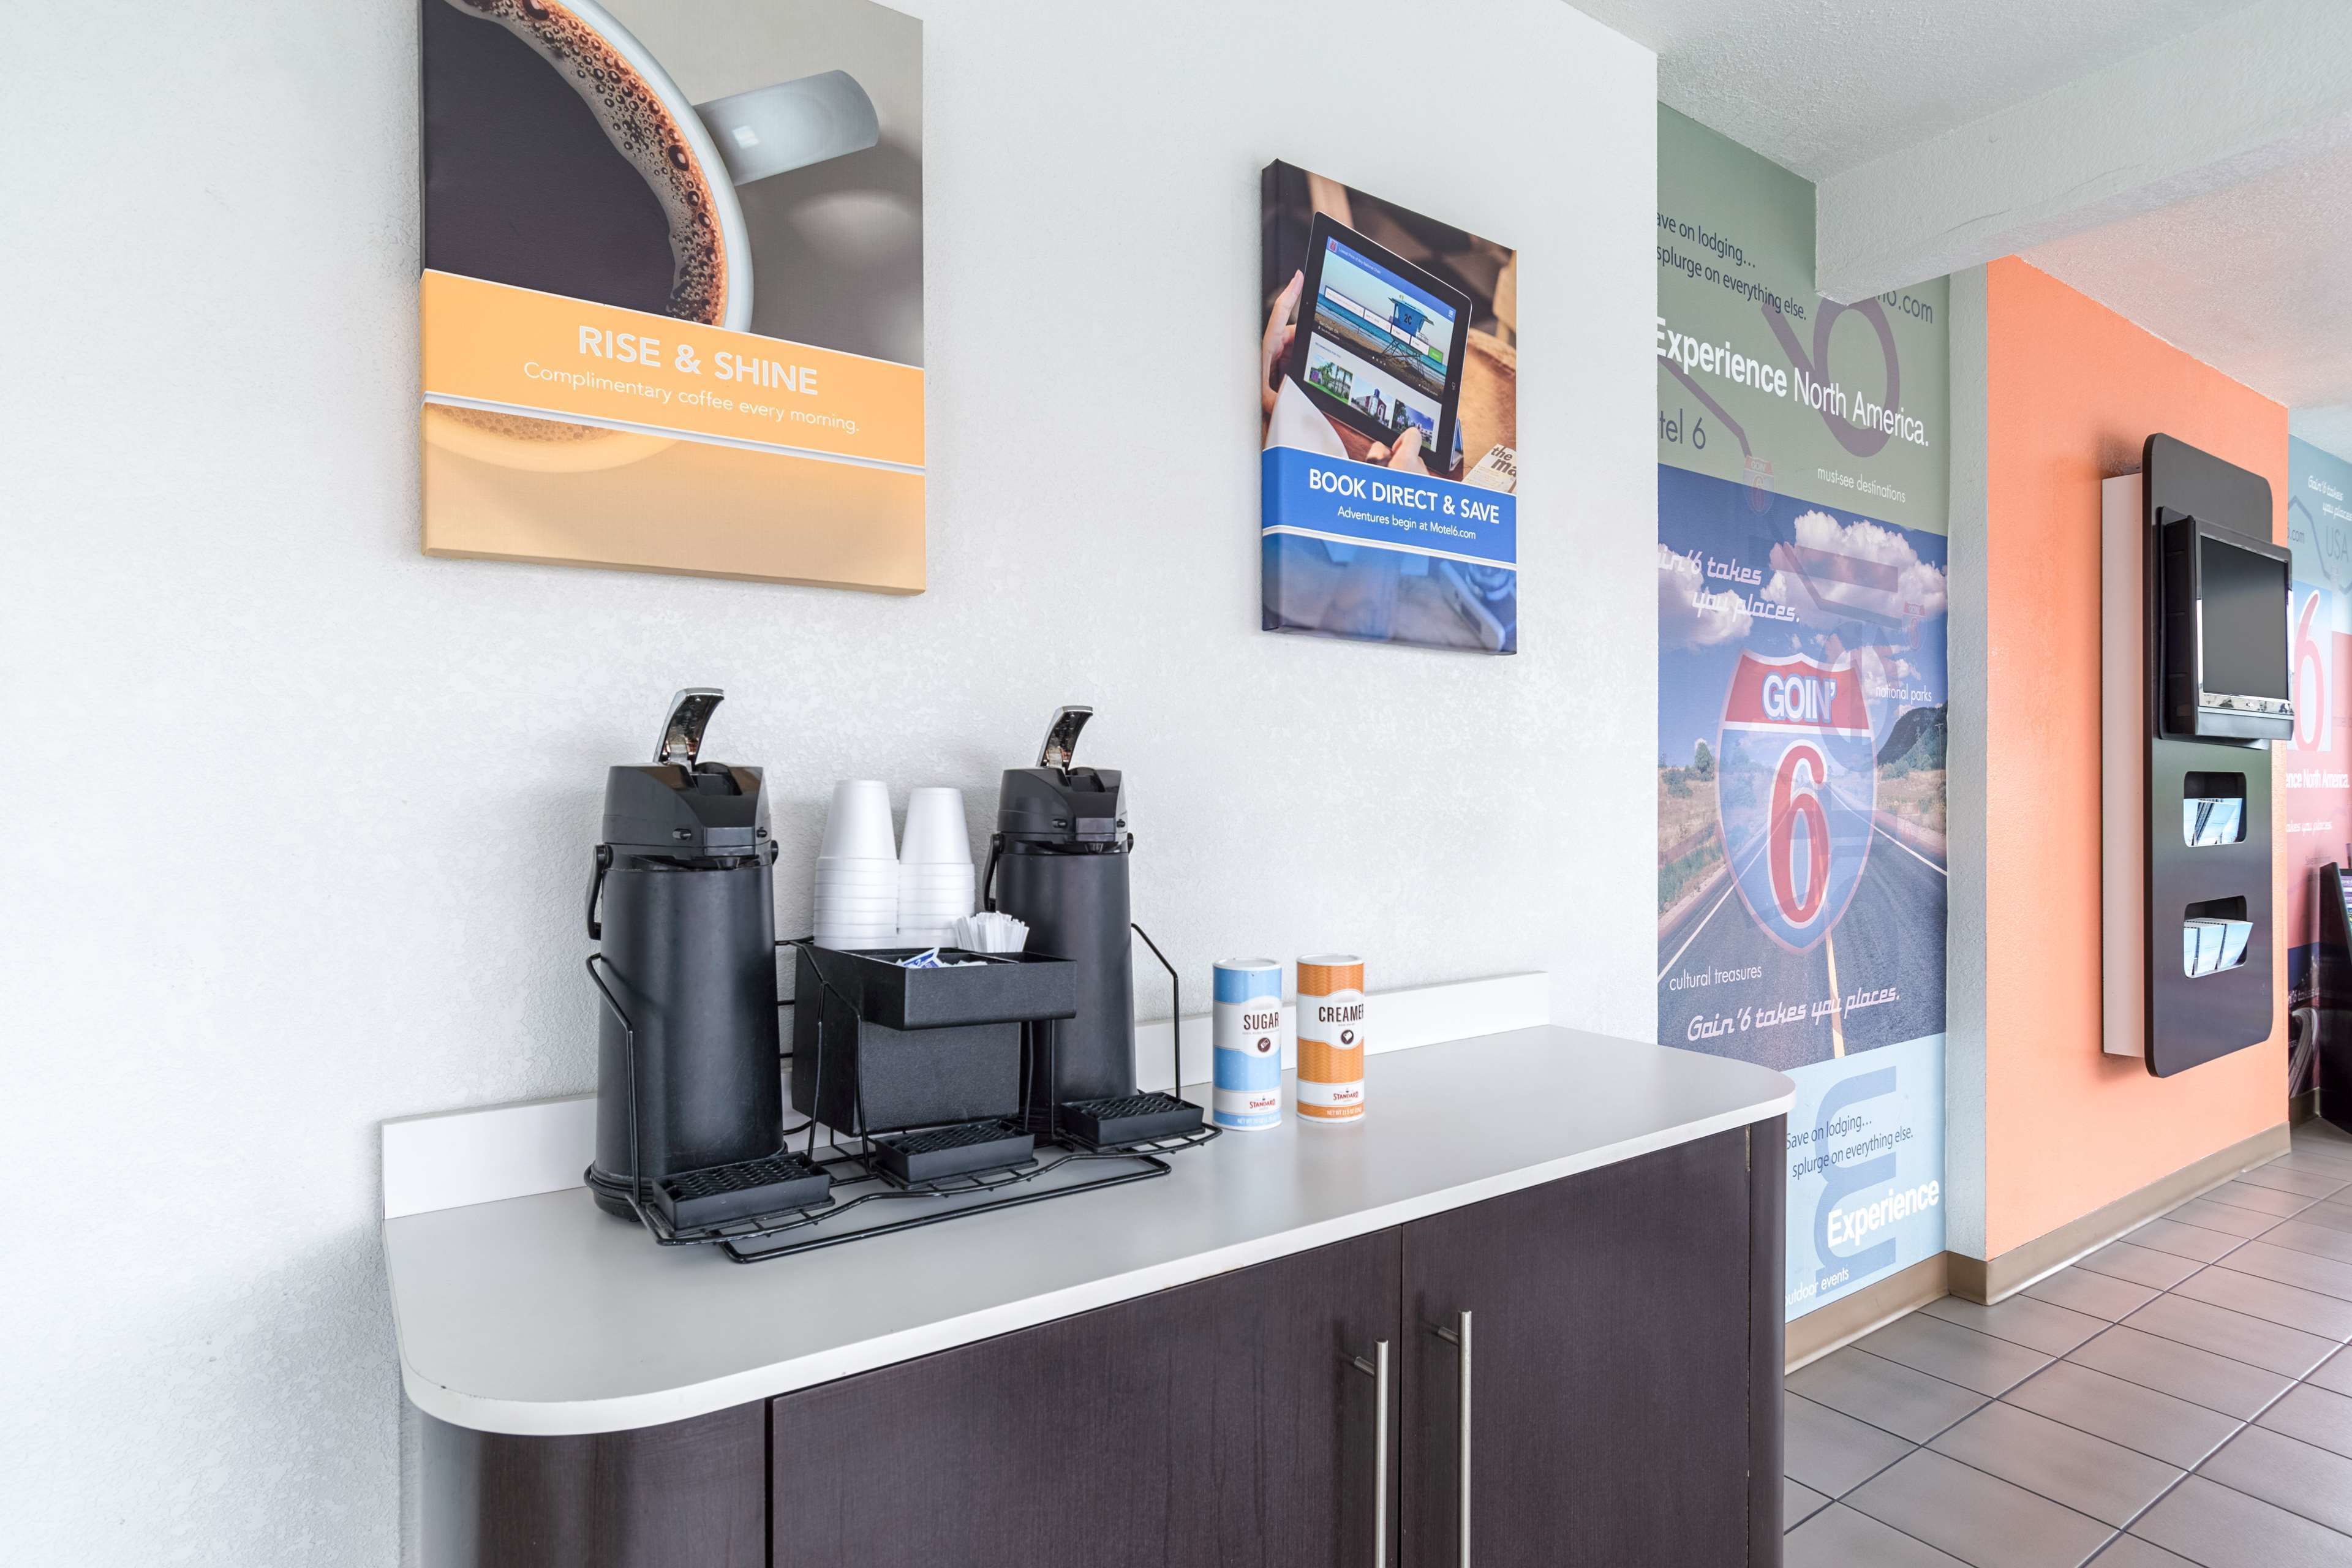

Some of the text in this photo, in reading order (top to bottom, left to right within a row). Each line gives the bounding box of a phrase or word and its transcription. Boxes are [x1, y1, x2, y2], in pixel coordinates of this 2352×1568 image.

[1679, 224, 1695, 241] on
[1698, 225, 1755, 268] lodging...
[1657, 246, 1807, 321] splurge on everything else.
[579, 325, 819, 396] RISE & SHINE
[524, 361, 859, 435] Complimentary coffee every morning.
[1657, 316, 1929, 447] Experience North America.
[1660, 408, 1706, 450] tel 6
[1491, 447, 1513, 461] the
[1310, 468, 1499, 524] BOOK DIRECT & SAVE
[1817, 467, 1905, 503] must-see destinations
[1338, 505, 1476, 540] Adventures begin at Motel6.com
[2288, 527, 2305, 544] .com
[2326, 526, 2348, 562] USA
[1707, 557, 1762, 586] takes
[1692, 592, 1800, 623] you places.
[1762, 672, 1838, 723] GOIN'
[1875, 684, 1932, 705] national parks
[1767, 739, 1833, 929] 6
[1669, 964, 1762, 991] cultural treasures
[1243, 1012, 1279, 1030] SUGAR
[1755, 1001, 1806, 1027] takes
[1811, 998, 1841, 1025] you
[1844, 986, 1900, 1019] places.
[1787, 1115, 1872, 1150] Save on lodging...
[1792, 1126, 1913, 1180] splurge on everything else.
[1828, 1180, 1939, 1248] Experience
[1821, 1267, 1849, 1291] events
